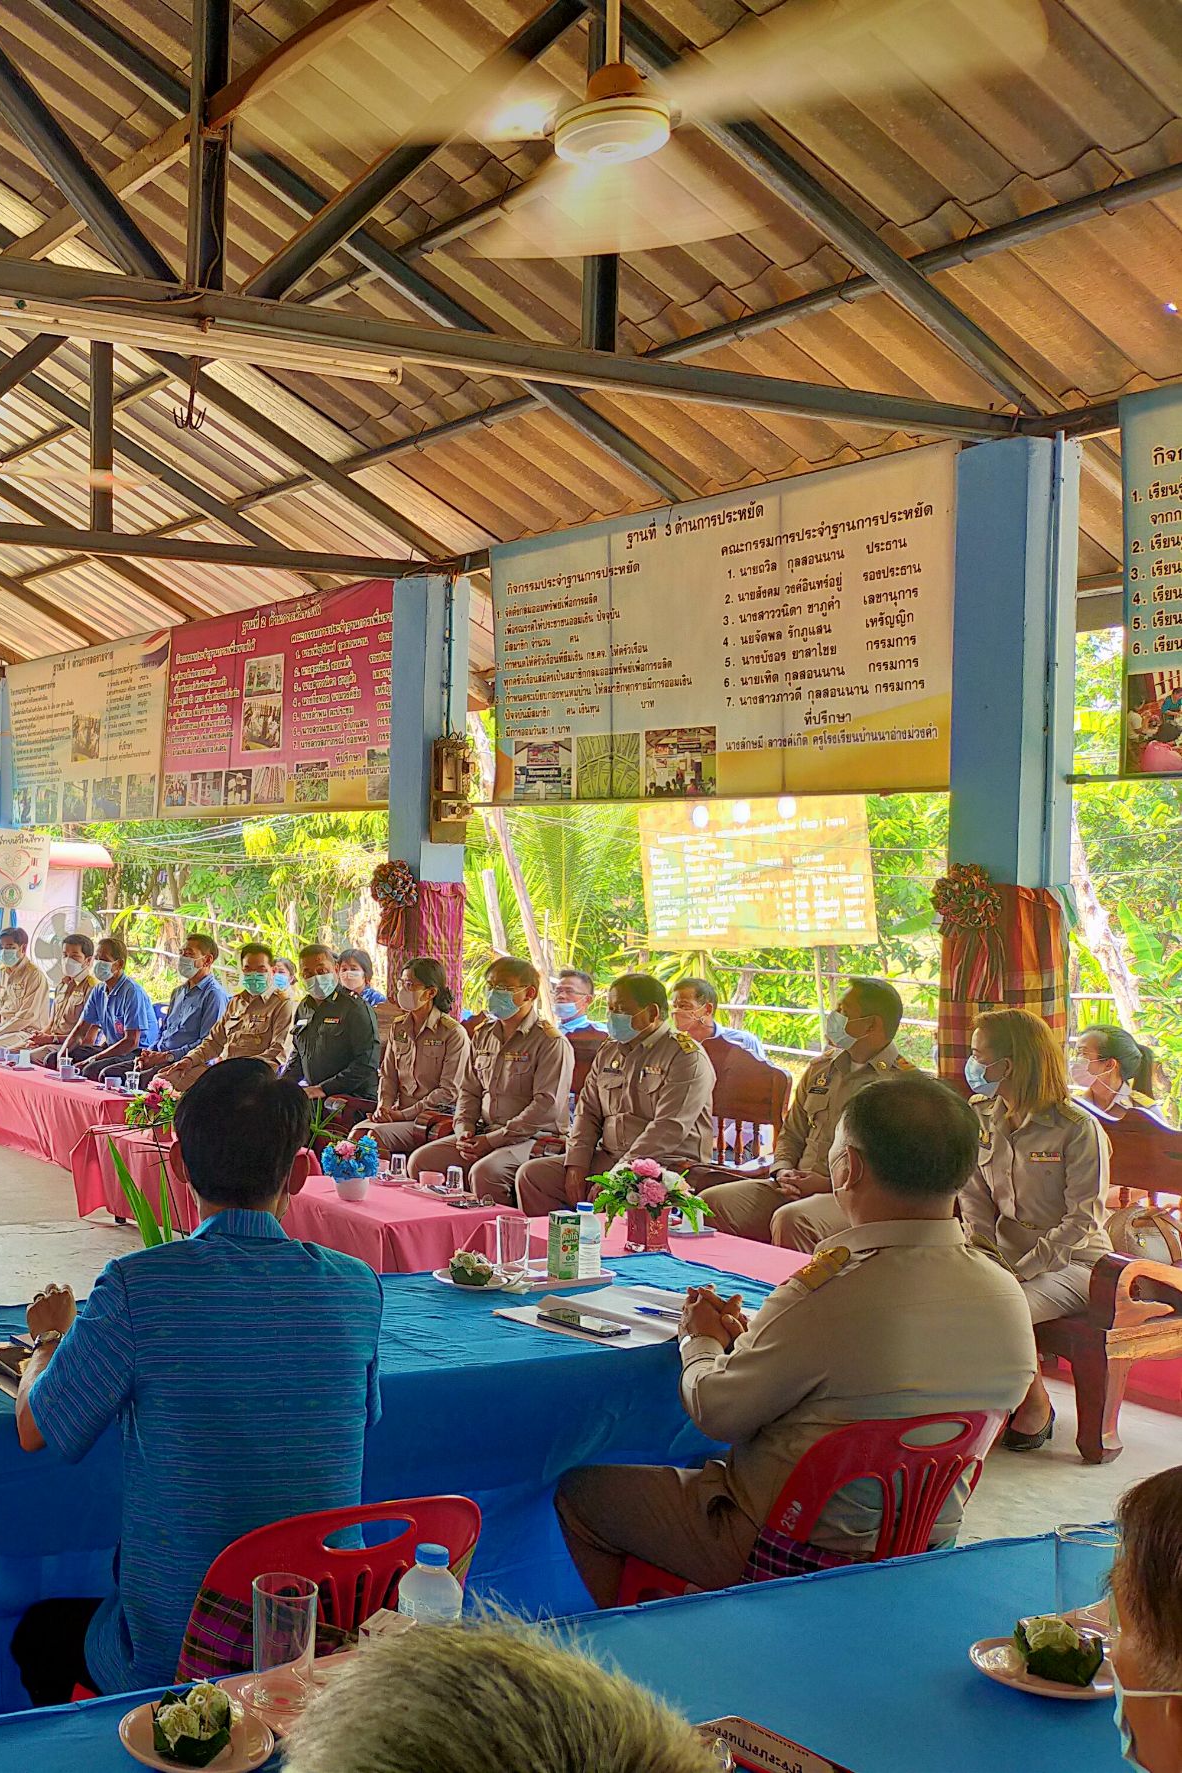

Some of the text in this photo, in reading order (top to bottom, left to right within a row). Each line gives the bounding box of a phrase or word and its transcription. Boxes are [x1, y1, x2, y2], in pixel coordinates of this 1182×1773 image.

[1132, 490, 1142, 502] 1.
[626, 502, 764, 550] ฐานที่ 3 ด้านการประหยัด
[721, 502, 933, 557] คณะกรรมการประจำฐานการประหยัด
[866, 536, 907, 554] ประธาน
[1133, 541, 1144, 553] 2.
[507, 562, 640, 595] กิจกรรมประจำฐานการประหยัด
[862, 562, 921, 582] รองประธาน
[863, 587, 919, 609] เลขานุการ
[866, 634, 917, 651] กรรมการ
[785, 665, 845, 687] กุลสอนนาน
[869, 657, 919, 672] กรรมการ
[807, 682, 869, 704] กุลสอนนาน
[875, 679, 925, 693] กรรมการ
[804, 708, 851, 725] ที่ปรึกษา
